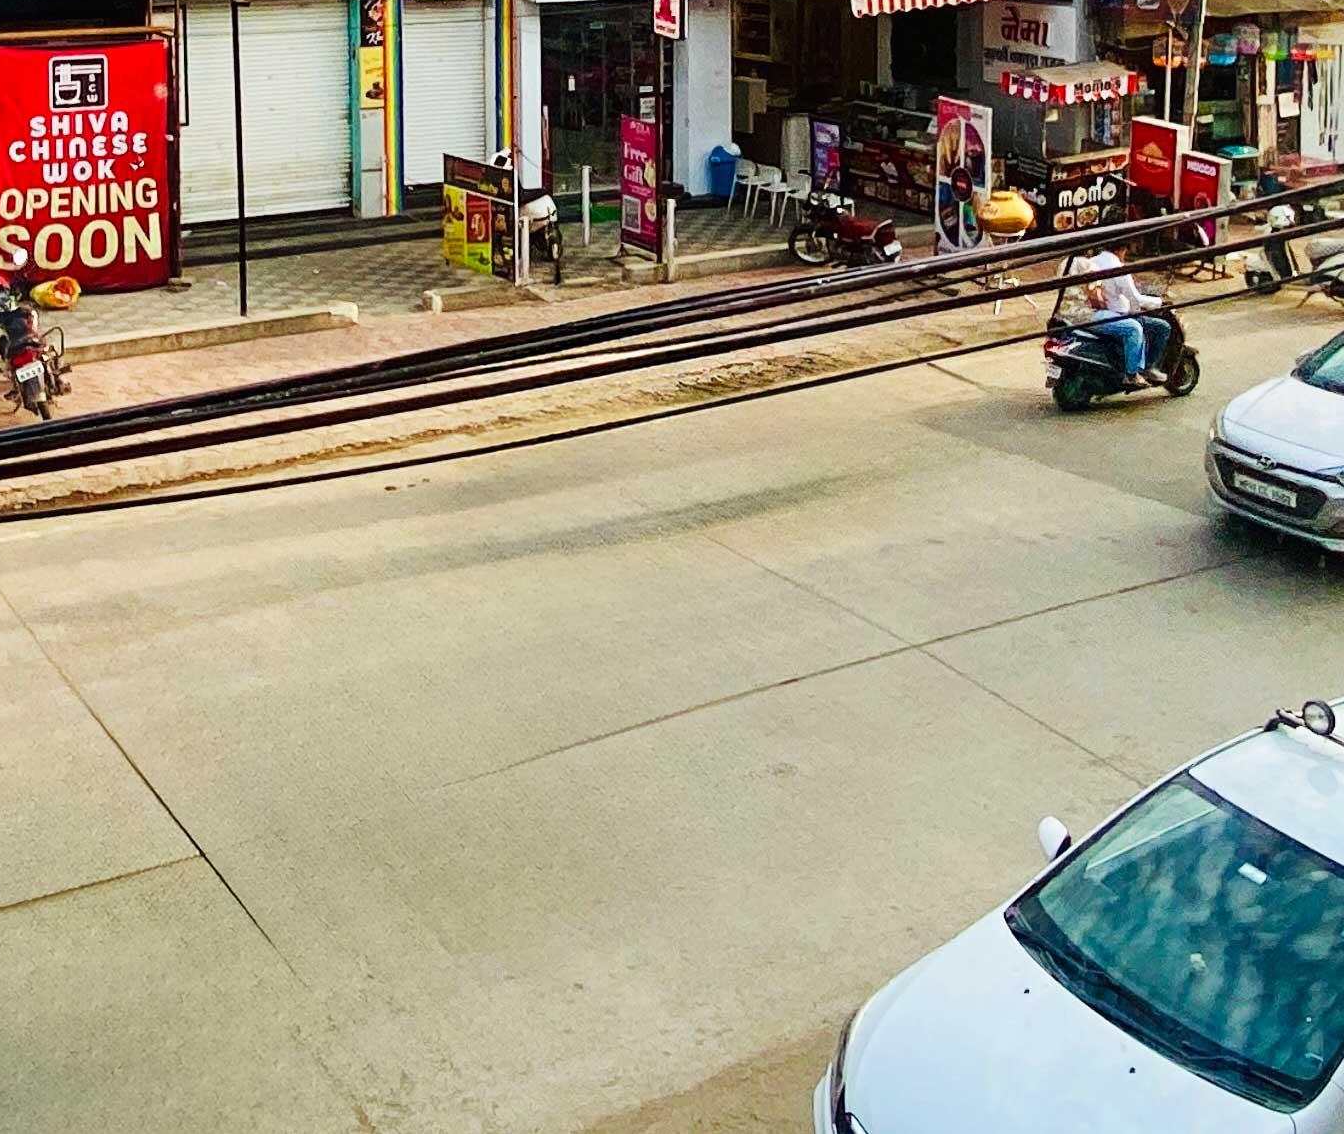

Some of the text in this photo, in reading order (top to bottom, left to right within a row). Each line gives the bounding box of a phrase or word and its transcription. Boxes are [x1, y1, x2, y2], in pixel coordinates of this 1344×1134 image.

[1000, 5, 1050, 48] नेमा
[1073, 77, 1122, 96] Momo's
[29, 111, 130, 139] SHIVA
[8, 132, 148, 164] CHINESE
[623, 140, 649, 164] Free
[42, 158, 117, 184] WOK
